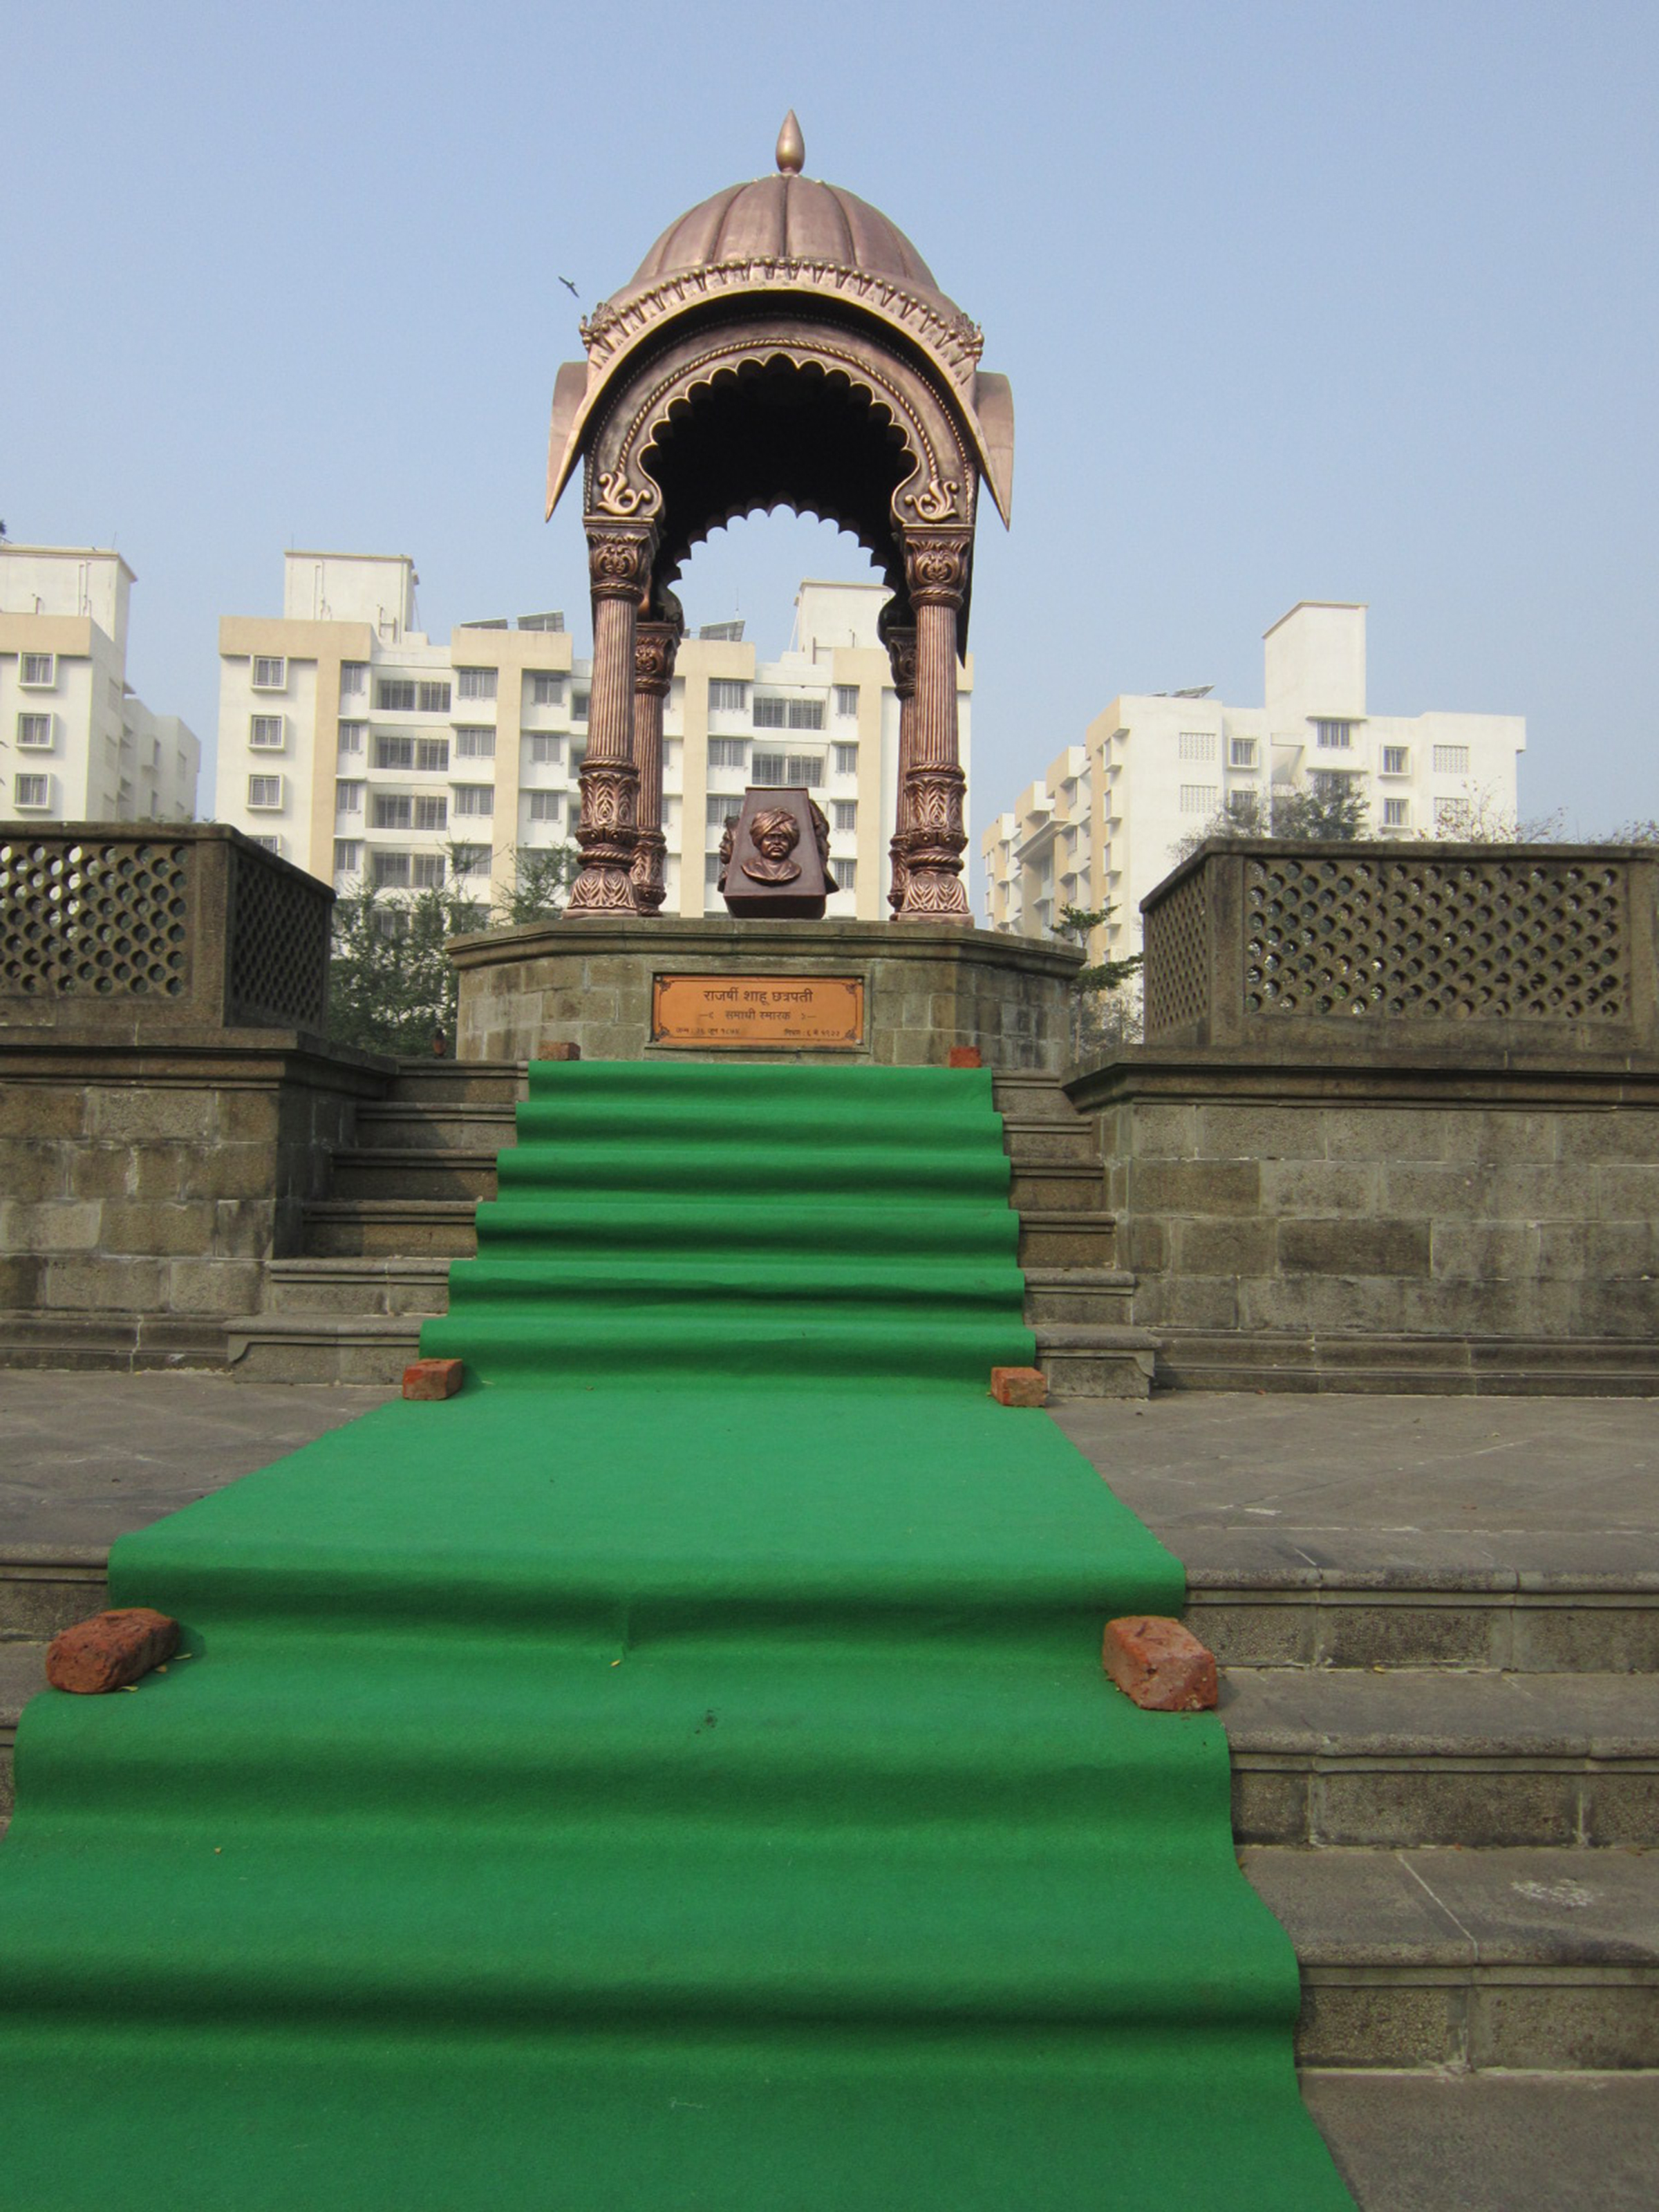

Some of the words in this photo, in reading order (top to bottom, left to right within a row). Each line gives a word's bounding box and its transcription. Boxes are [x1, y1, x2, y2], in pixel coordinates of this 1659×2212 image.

[704, 986, 739, 1001] राजर्षी
[744, 991, 769, 1005] शाहू
[771, 988, 814, 1002] छत्रपती
[725, 1007, 756, 1020] समाधी
[760, 1011, 791, 1020] स्मारक
